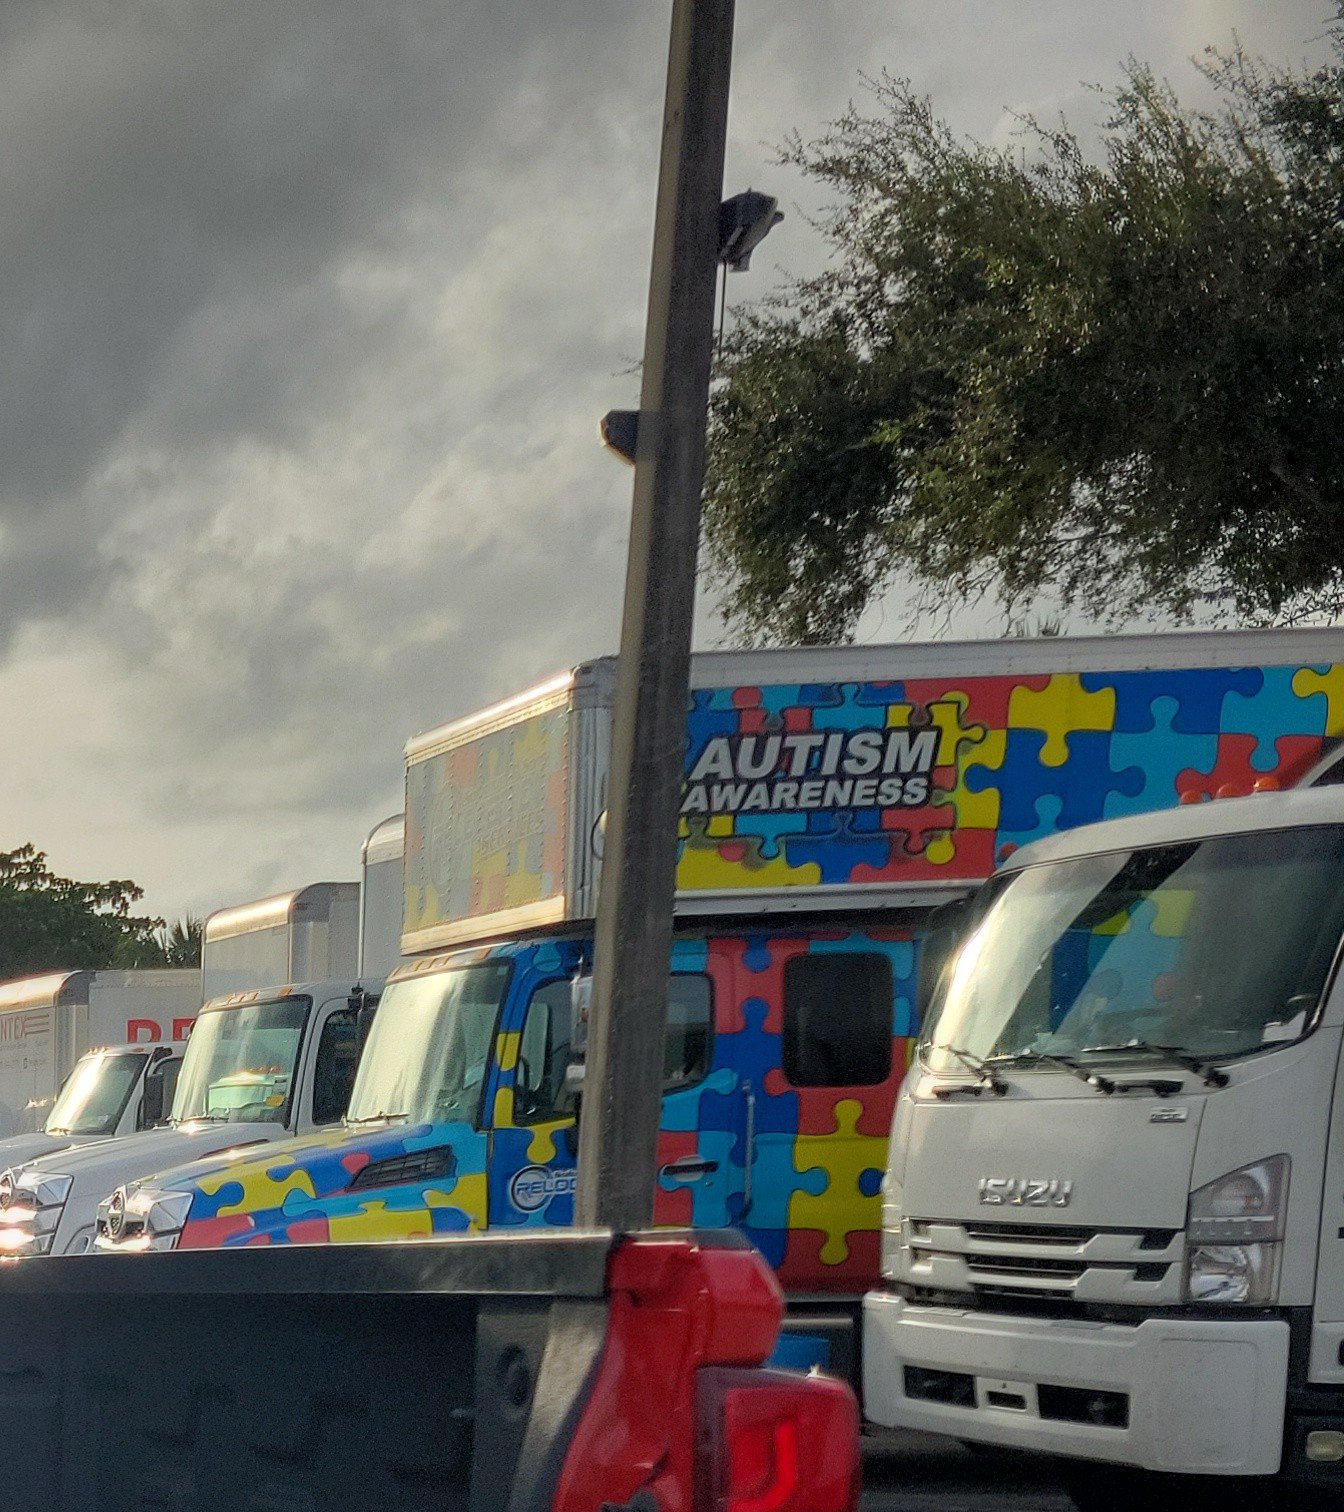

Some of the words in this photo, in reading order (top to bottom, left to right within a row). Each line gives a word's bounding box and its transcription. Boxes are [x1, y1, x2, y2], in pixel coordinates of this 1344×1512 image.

[688, 730, 937, 780] AUTISM
[679, 777, 929, 814] AWARENESS
[978, 1178, 1073, 1208] ISUZU
